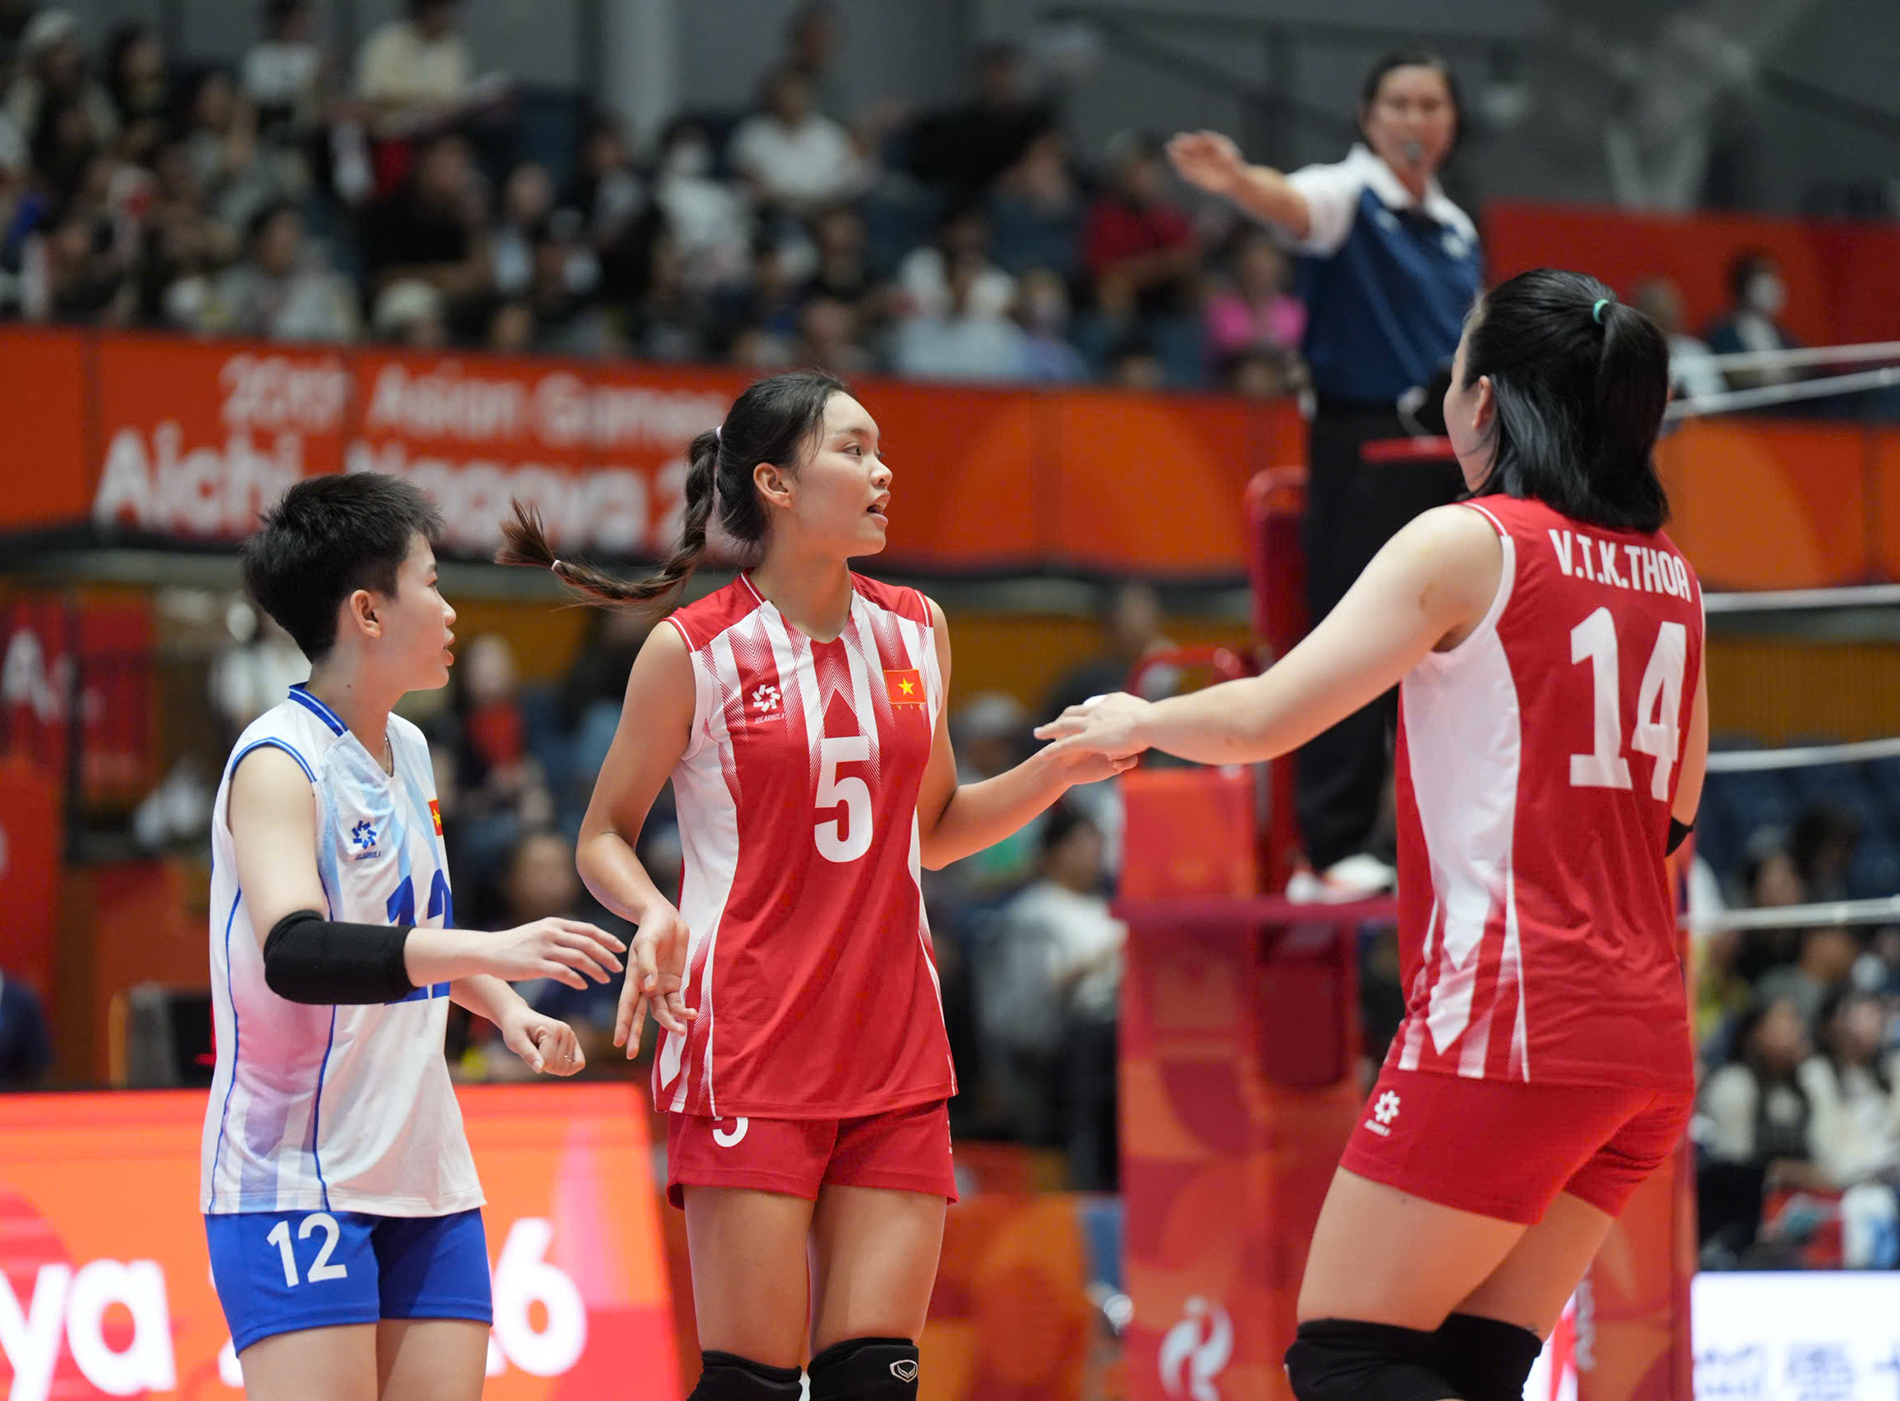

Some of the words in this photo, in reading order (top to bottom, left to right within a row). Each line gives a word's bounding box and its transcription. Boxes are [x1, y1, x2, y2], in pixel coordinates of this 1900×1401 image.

[1548, 528, 1692, 603] V.T.K.THOA
[1570, 606, 1688, 802] 14
[814, 735, 873, 863] 5
[266, 1212, 348, 1288] 12
